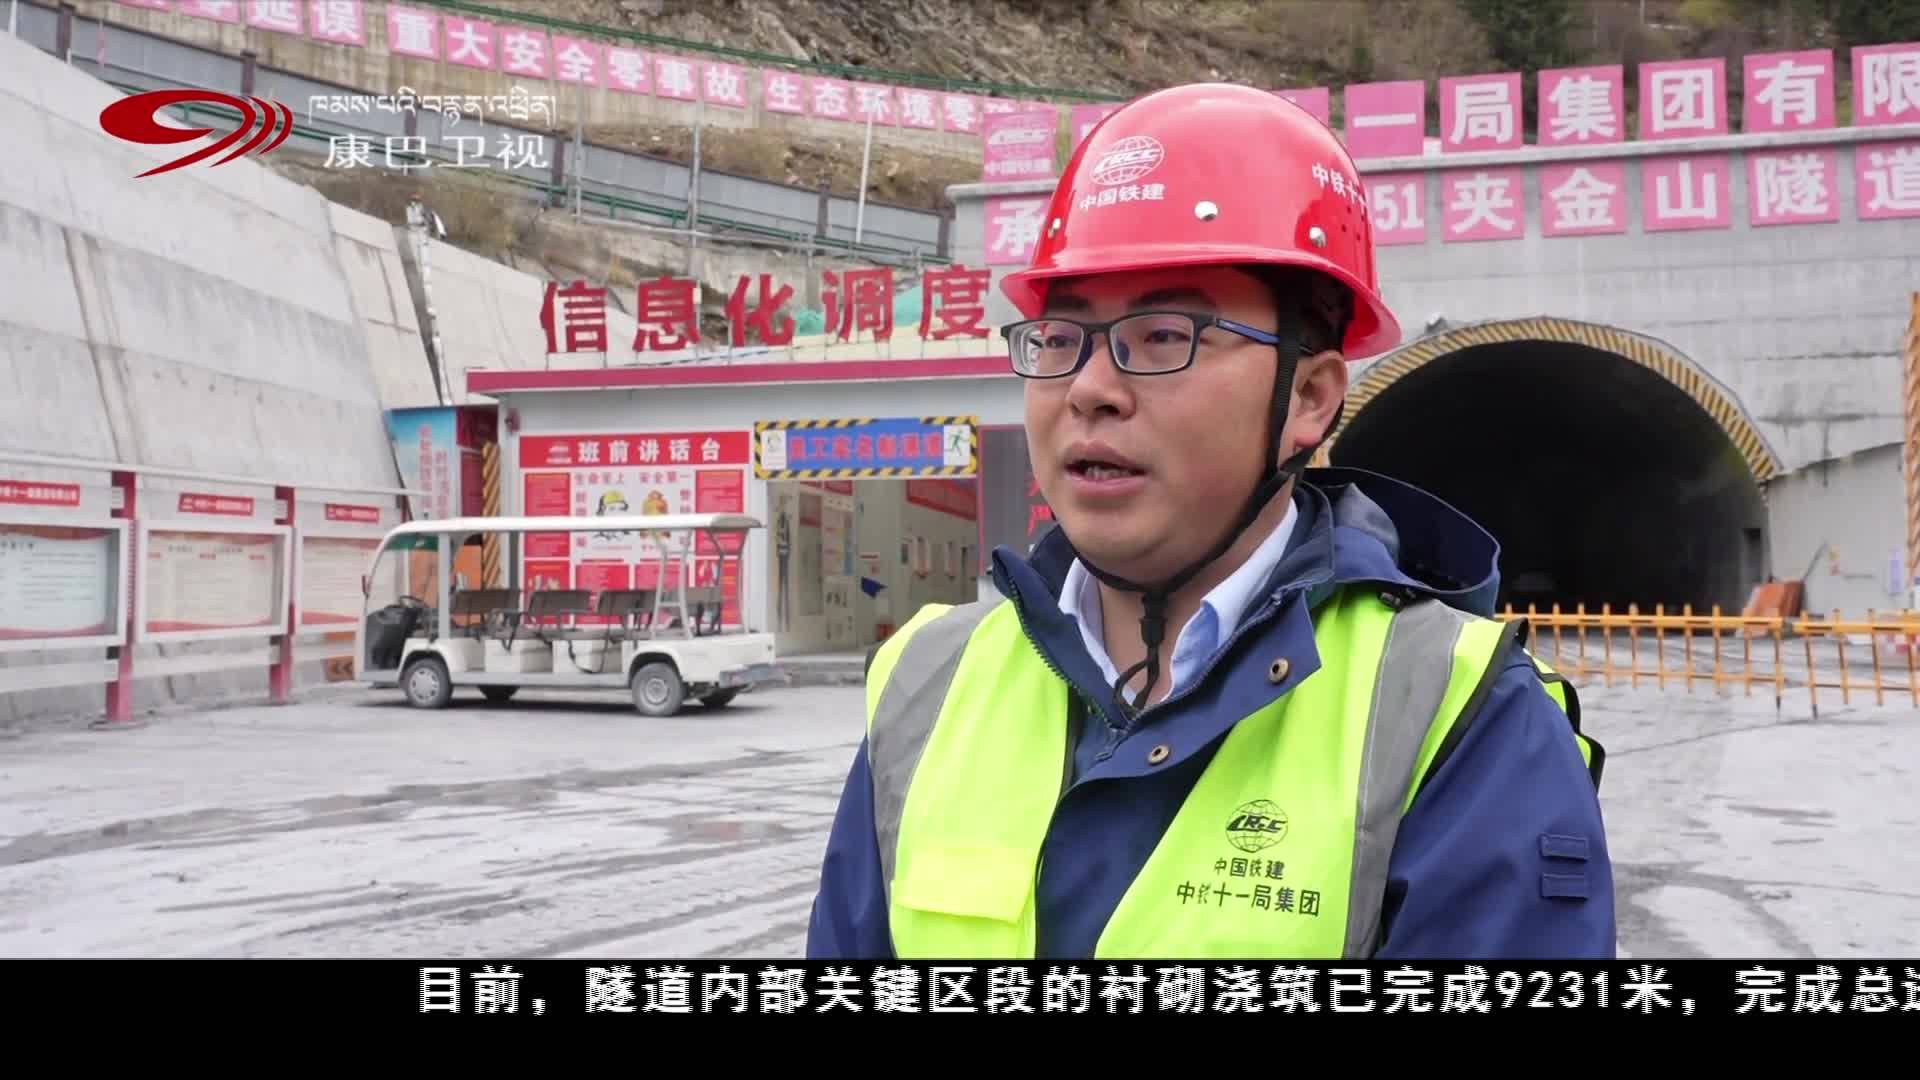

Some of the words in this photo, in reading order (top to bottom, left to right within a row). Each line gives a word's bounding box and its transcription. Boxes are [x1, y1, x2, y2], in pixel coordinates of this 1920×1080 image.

[392, 8, 745, 105] 重大安全零事故
[1078, 183, 1166, 211] 中国铁建
[992, 200, 1045, 257] 承
[540, 264, 992, 353] 信息化调度
[578, 438, 721, 465] 班前讲话台
[1214, 857, 1285, 880] 中国铁建
[1176, 881, 1321, 917] 中铁十一局集团
